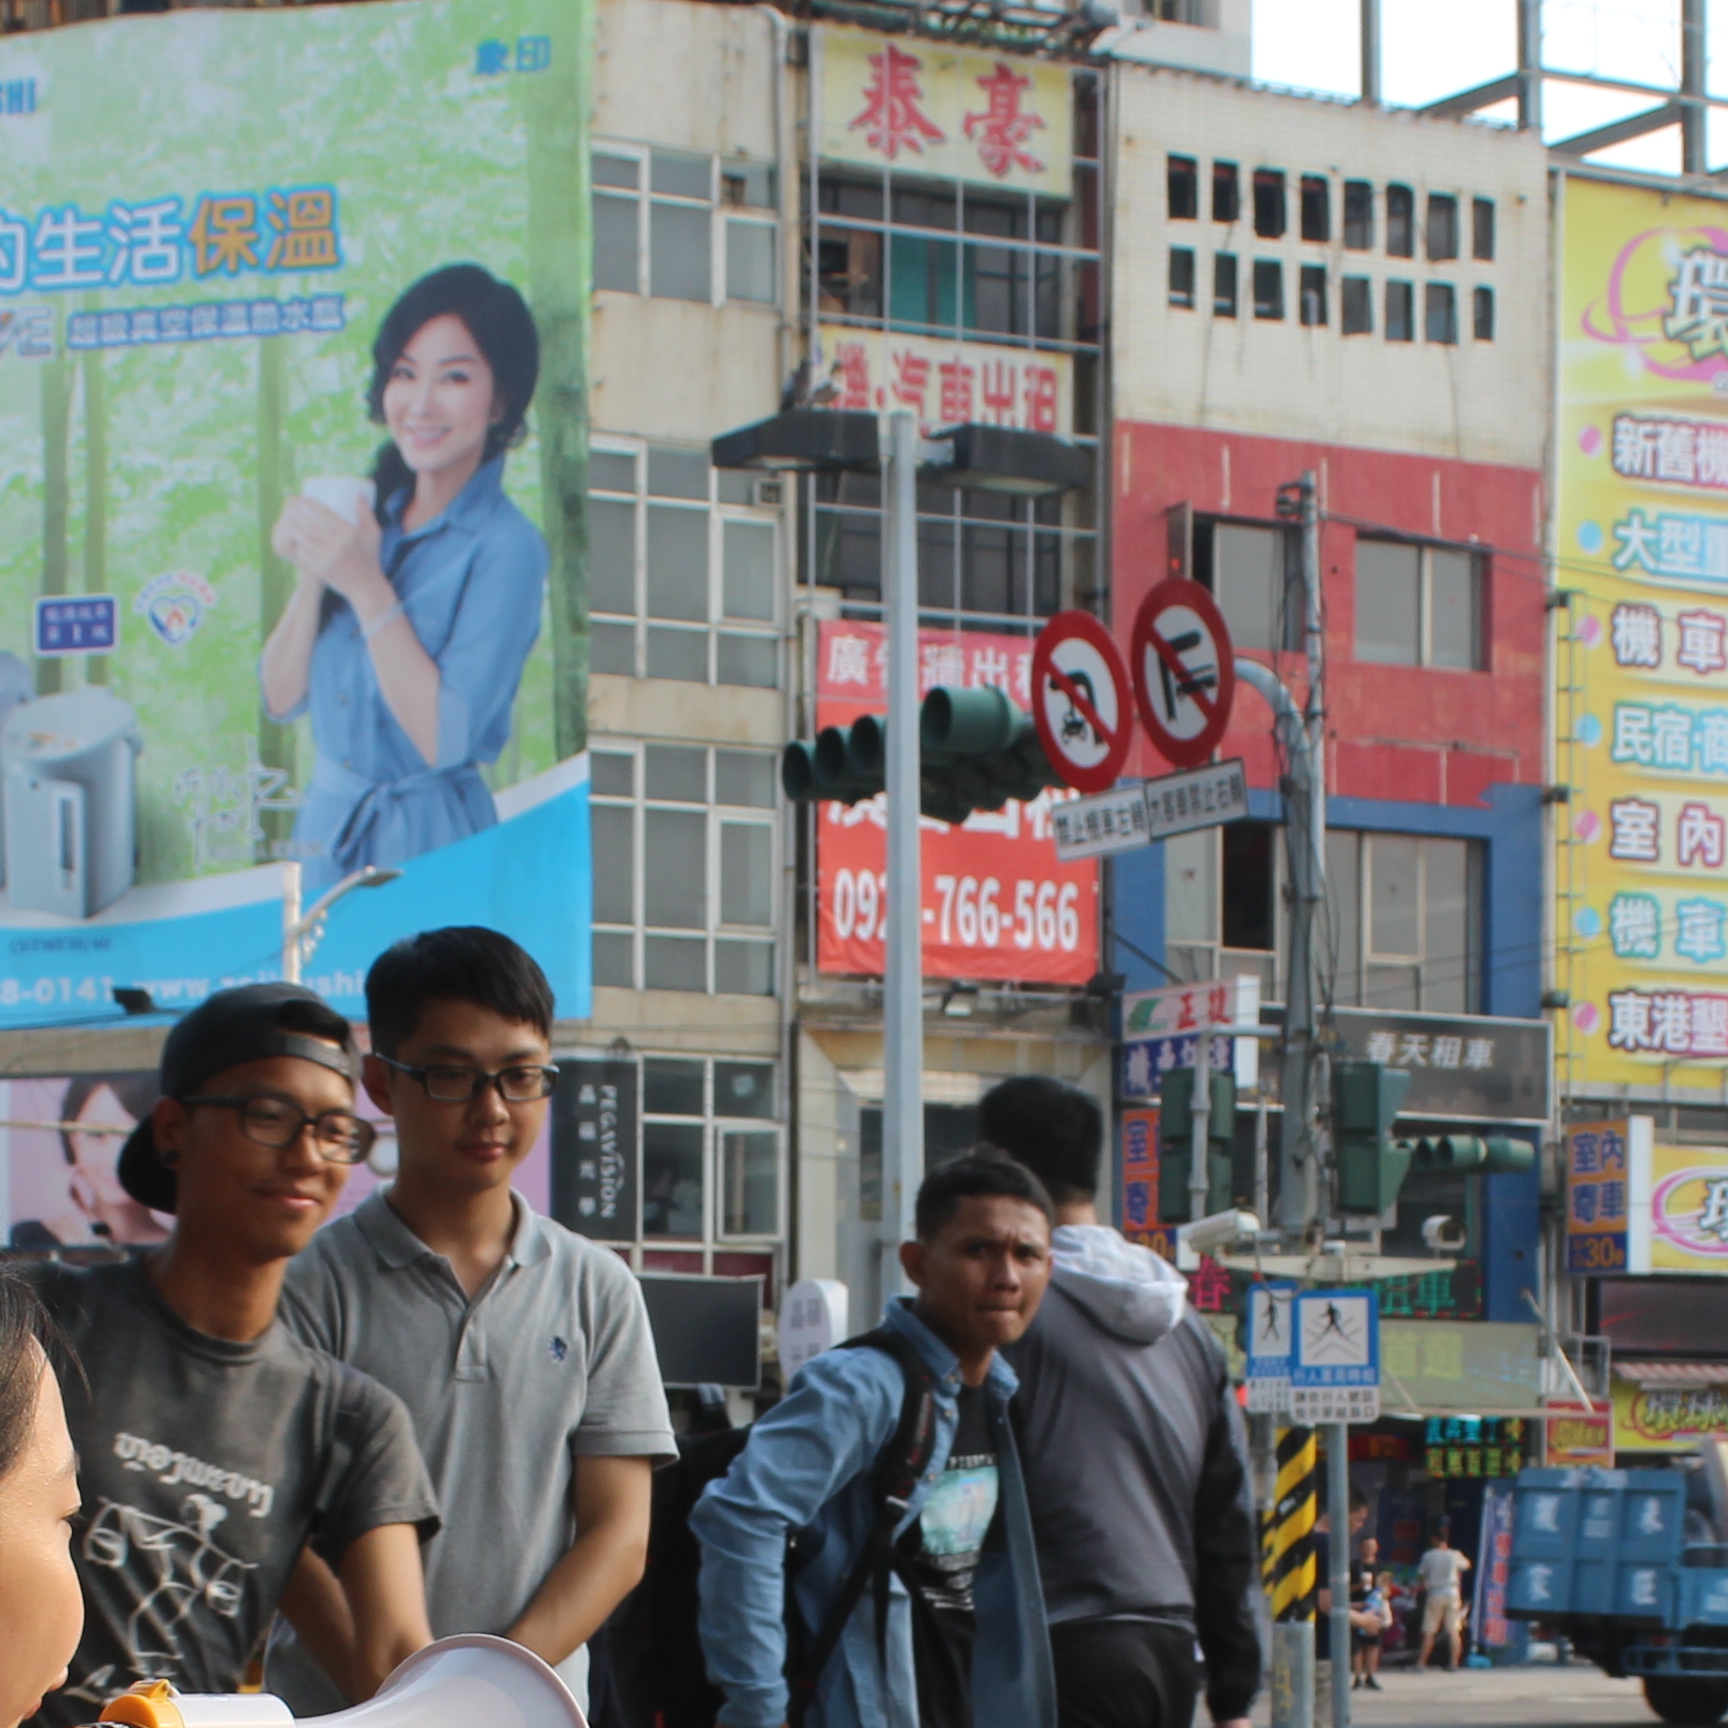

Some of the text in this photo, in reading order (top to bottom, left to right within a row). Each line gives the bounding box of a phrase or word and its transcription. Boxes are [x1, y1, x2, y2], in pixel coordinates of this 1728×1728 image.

[474, 36, 553, 77] 象印
[850, 42, 1046, 176] 泰豪
[833, 866, 1080, 954] 09-766-566
[1366, 1030, 1496, 1072] 春天租車
